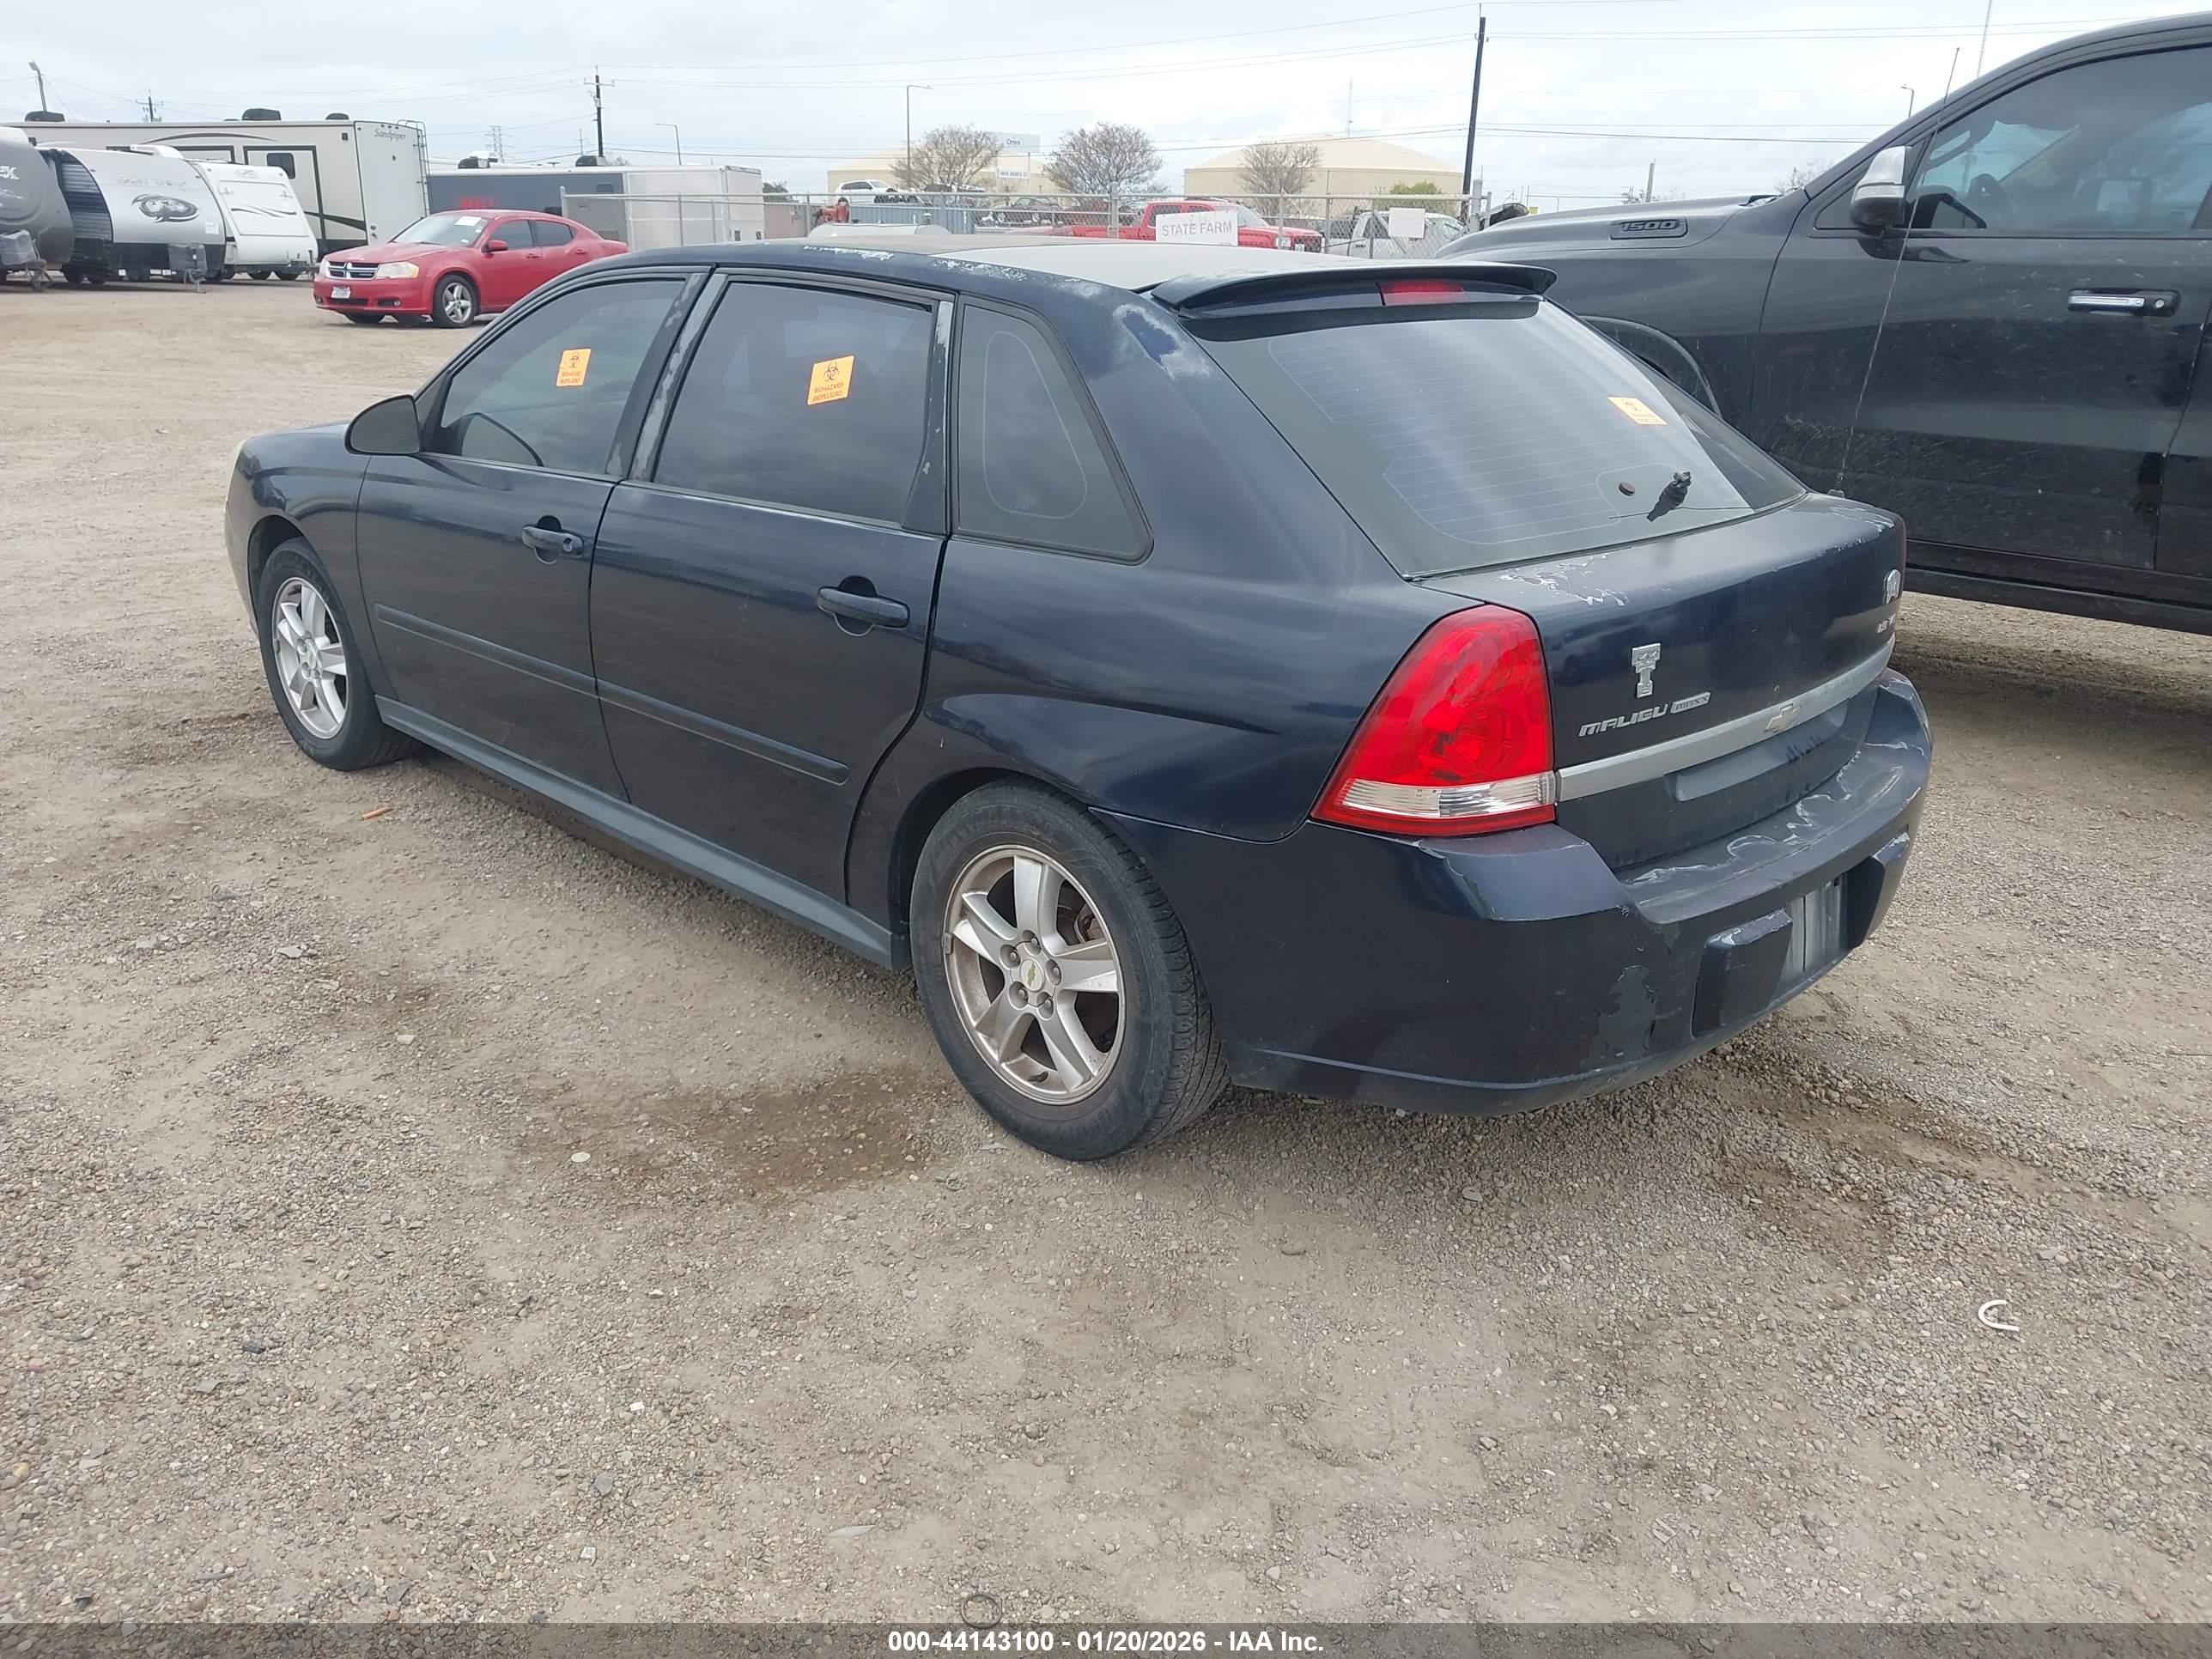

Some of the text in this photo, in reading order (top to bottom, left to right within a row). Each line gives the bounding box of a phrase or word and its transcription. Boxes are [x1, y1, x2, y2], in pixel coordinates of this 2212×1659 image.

[374, 128, 406, 142] Sandpiper
[1162, 221, 1232, 237] STATE FARM
[1620, 220, 1677, 231] 1500
[814, 381, 844, 393] BIOHAZARD
[1578, 704, 1668, 737] MALIBU
